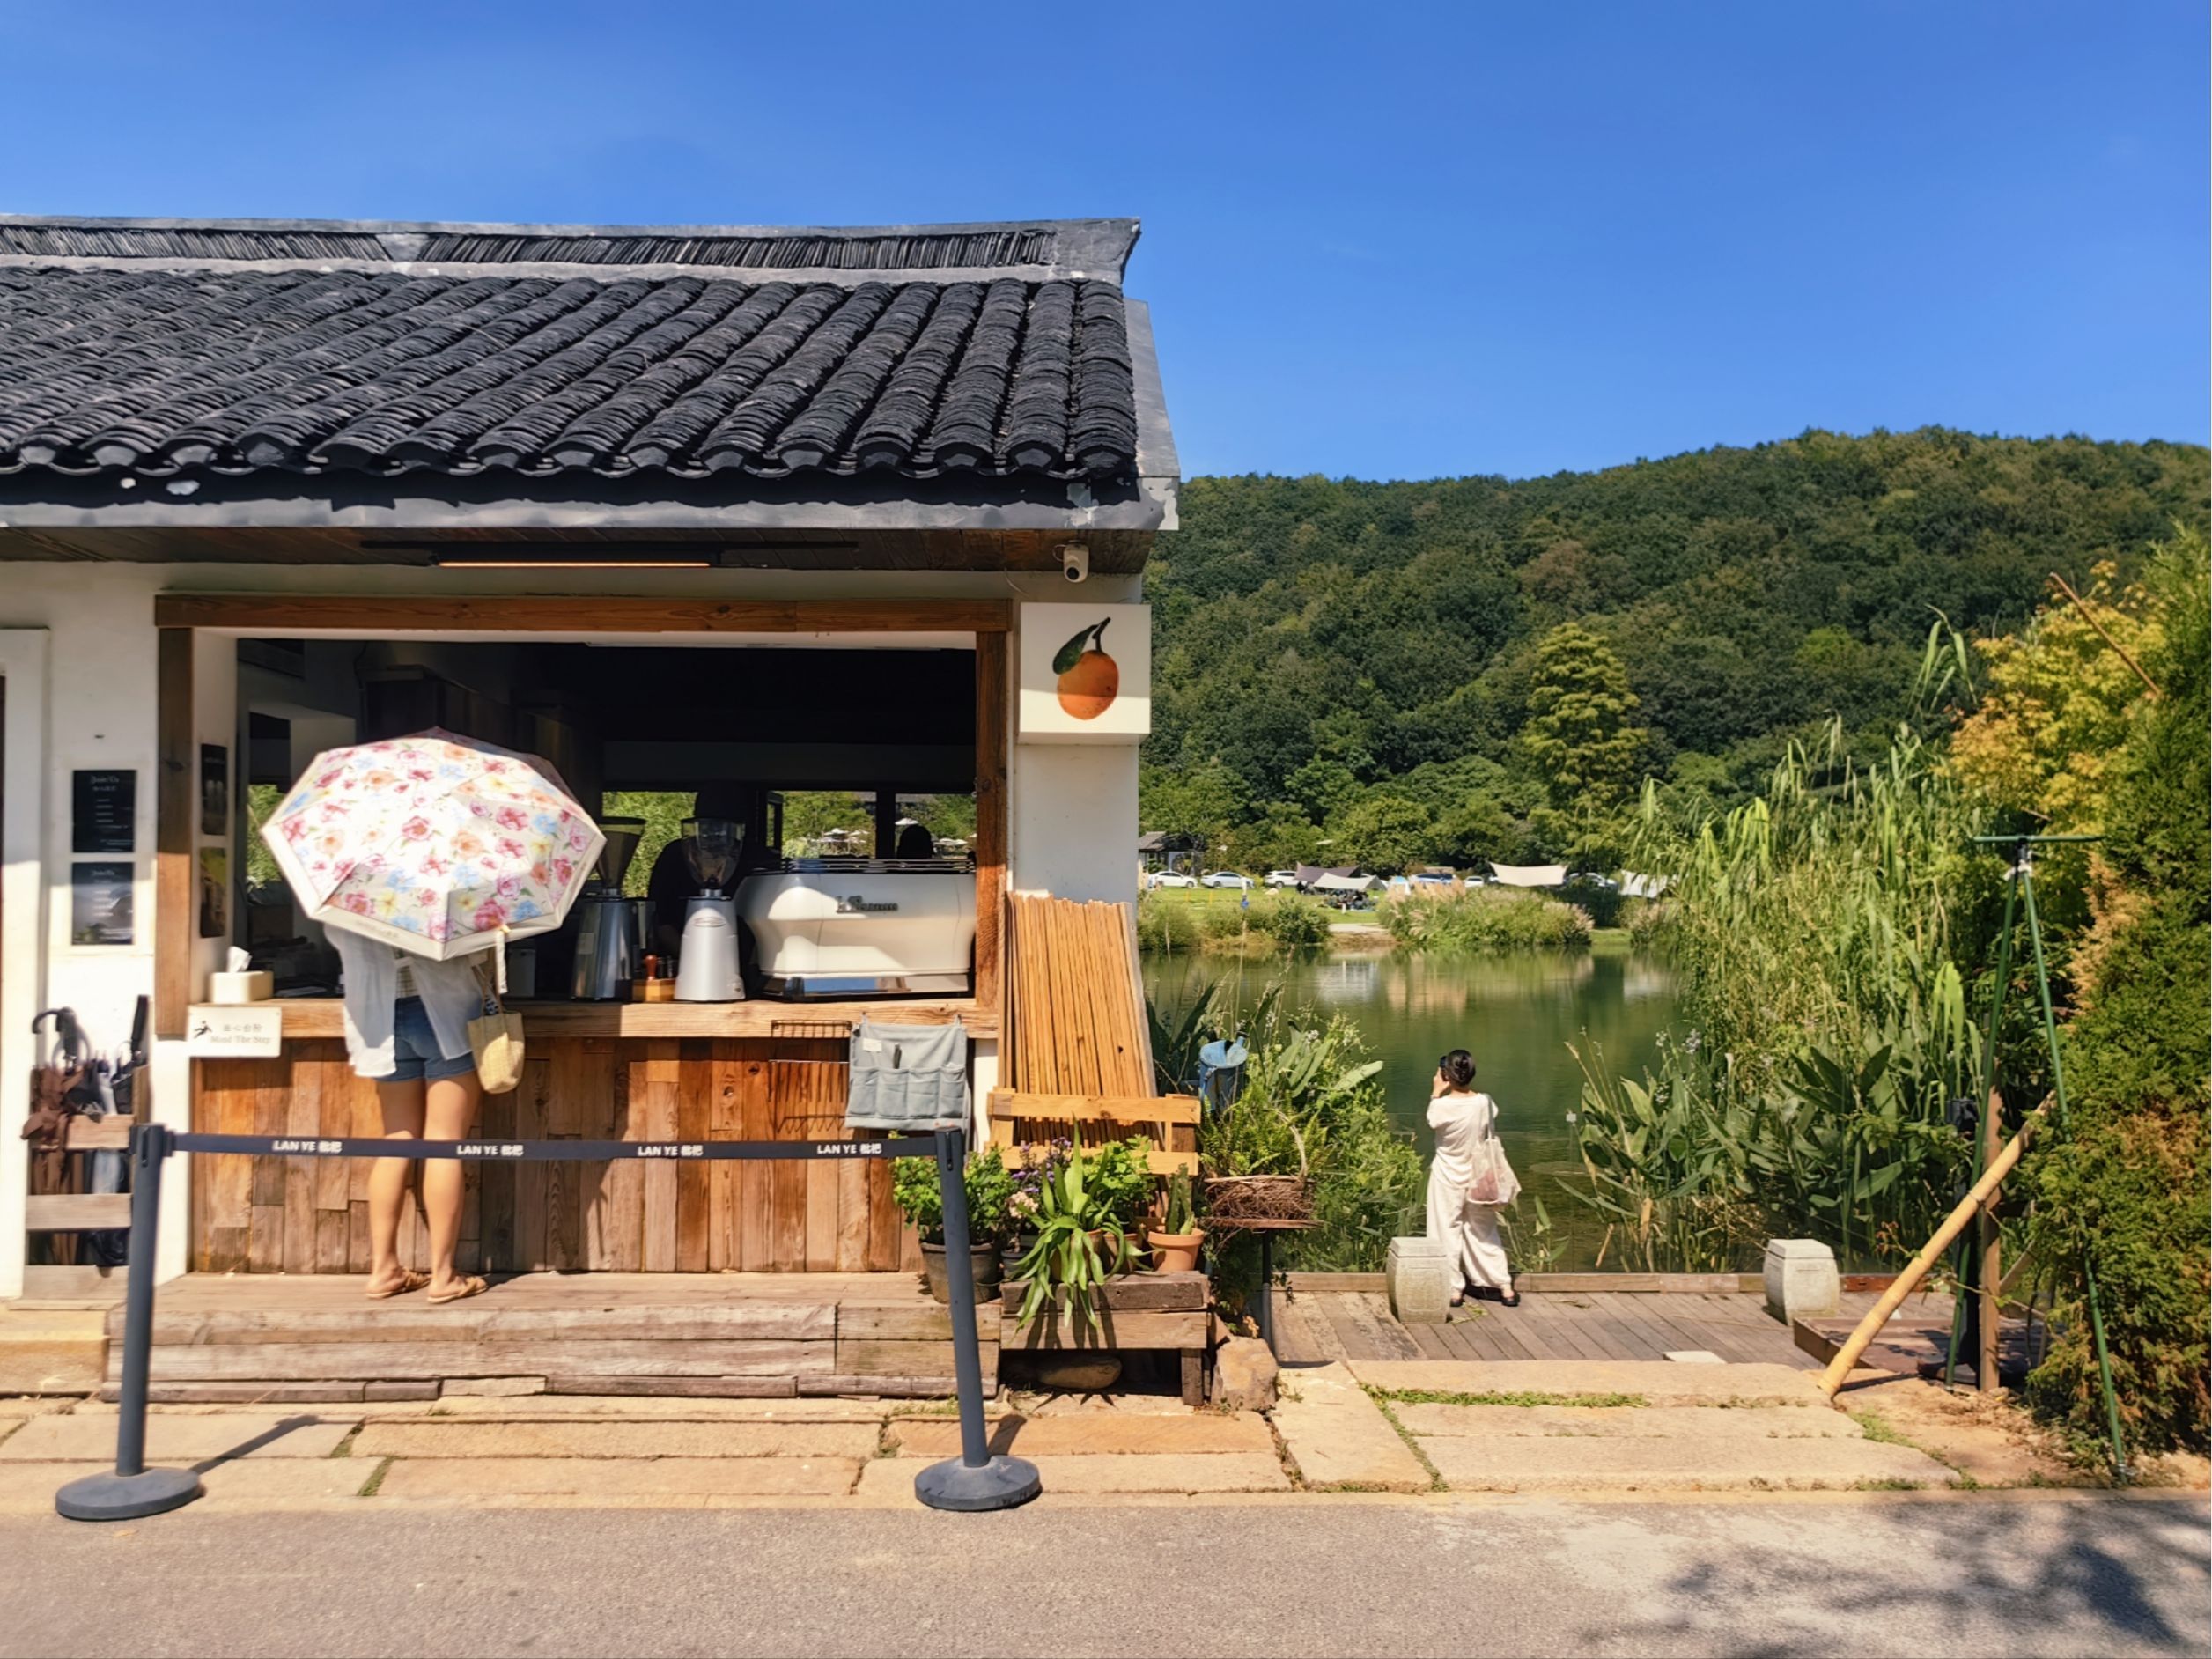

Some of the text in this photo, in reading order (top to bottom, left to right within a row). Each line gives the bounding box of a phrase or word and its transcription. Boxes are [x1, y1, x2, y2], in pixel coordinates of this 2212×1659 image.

[253, 1036, 272, 1045] Step
[272, 1140, 299, 1151] LAN
[300, 1141, 316, 1151] YE
[456, 1145, 482, 1154] LAN
[483, 1145, 498, 1155] YE
[817, 1145, 840, 1154] LAN
[843, 1144, 857, 1154] YE
[638, 1146, 661, 1156] LAN
[664, 1146, 678, 1156] YE
